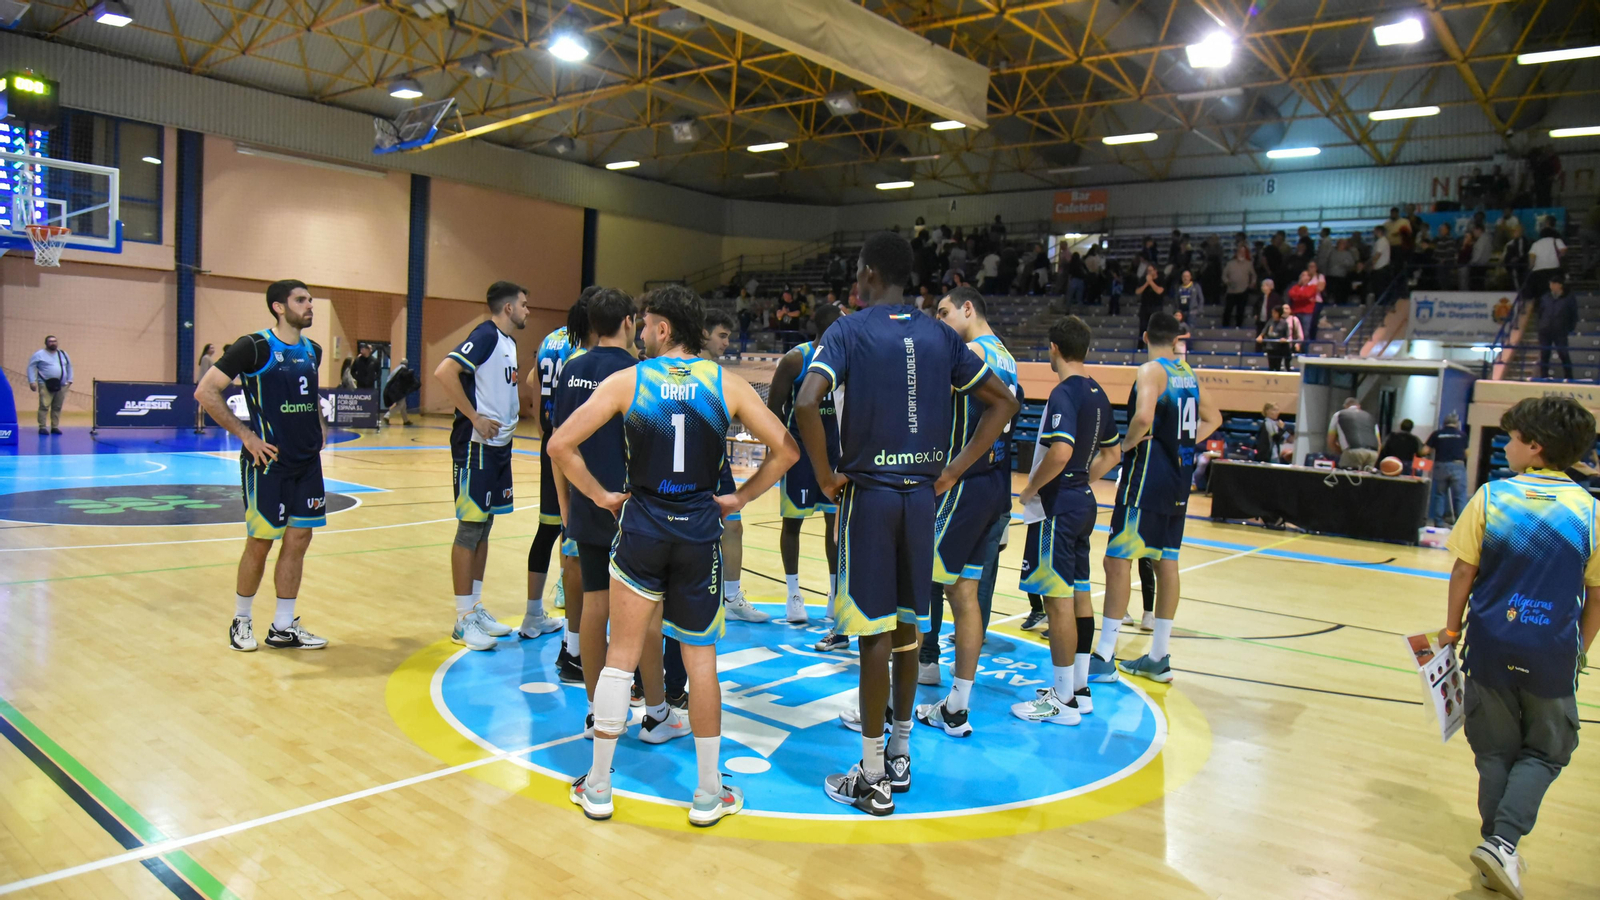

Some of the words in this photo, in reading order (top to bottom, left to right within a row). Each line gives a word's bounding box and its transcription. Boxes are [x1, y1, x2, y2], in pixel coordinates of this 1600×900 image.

[1071, 191, 1090, 201] Bar
[1266, 179, 1275, 194] B
[1448, 311, 1489, 320] Deportes
[461, 341, 474, 354] 0
[298, 375, 309, 395] 2
[903, 337, 918, 434] #LAFORTALEZADELSUR
[1177, 397, 1197, 440] 14
[671, 413, 685, 473] 1
[874, 447, 944, 466] damex.io
[486, 490, 492, 507] 0
[279, 502, 286, 521] 2
[1508, 592, 1554, 613] Algeciras
[1520, 609, 1551, 626] Gusta
